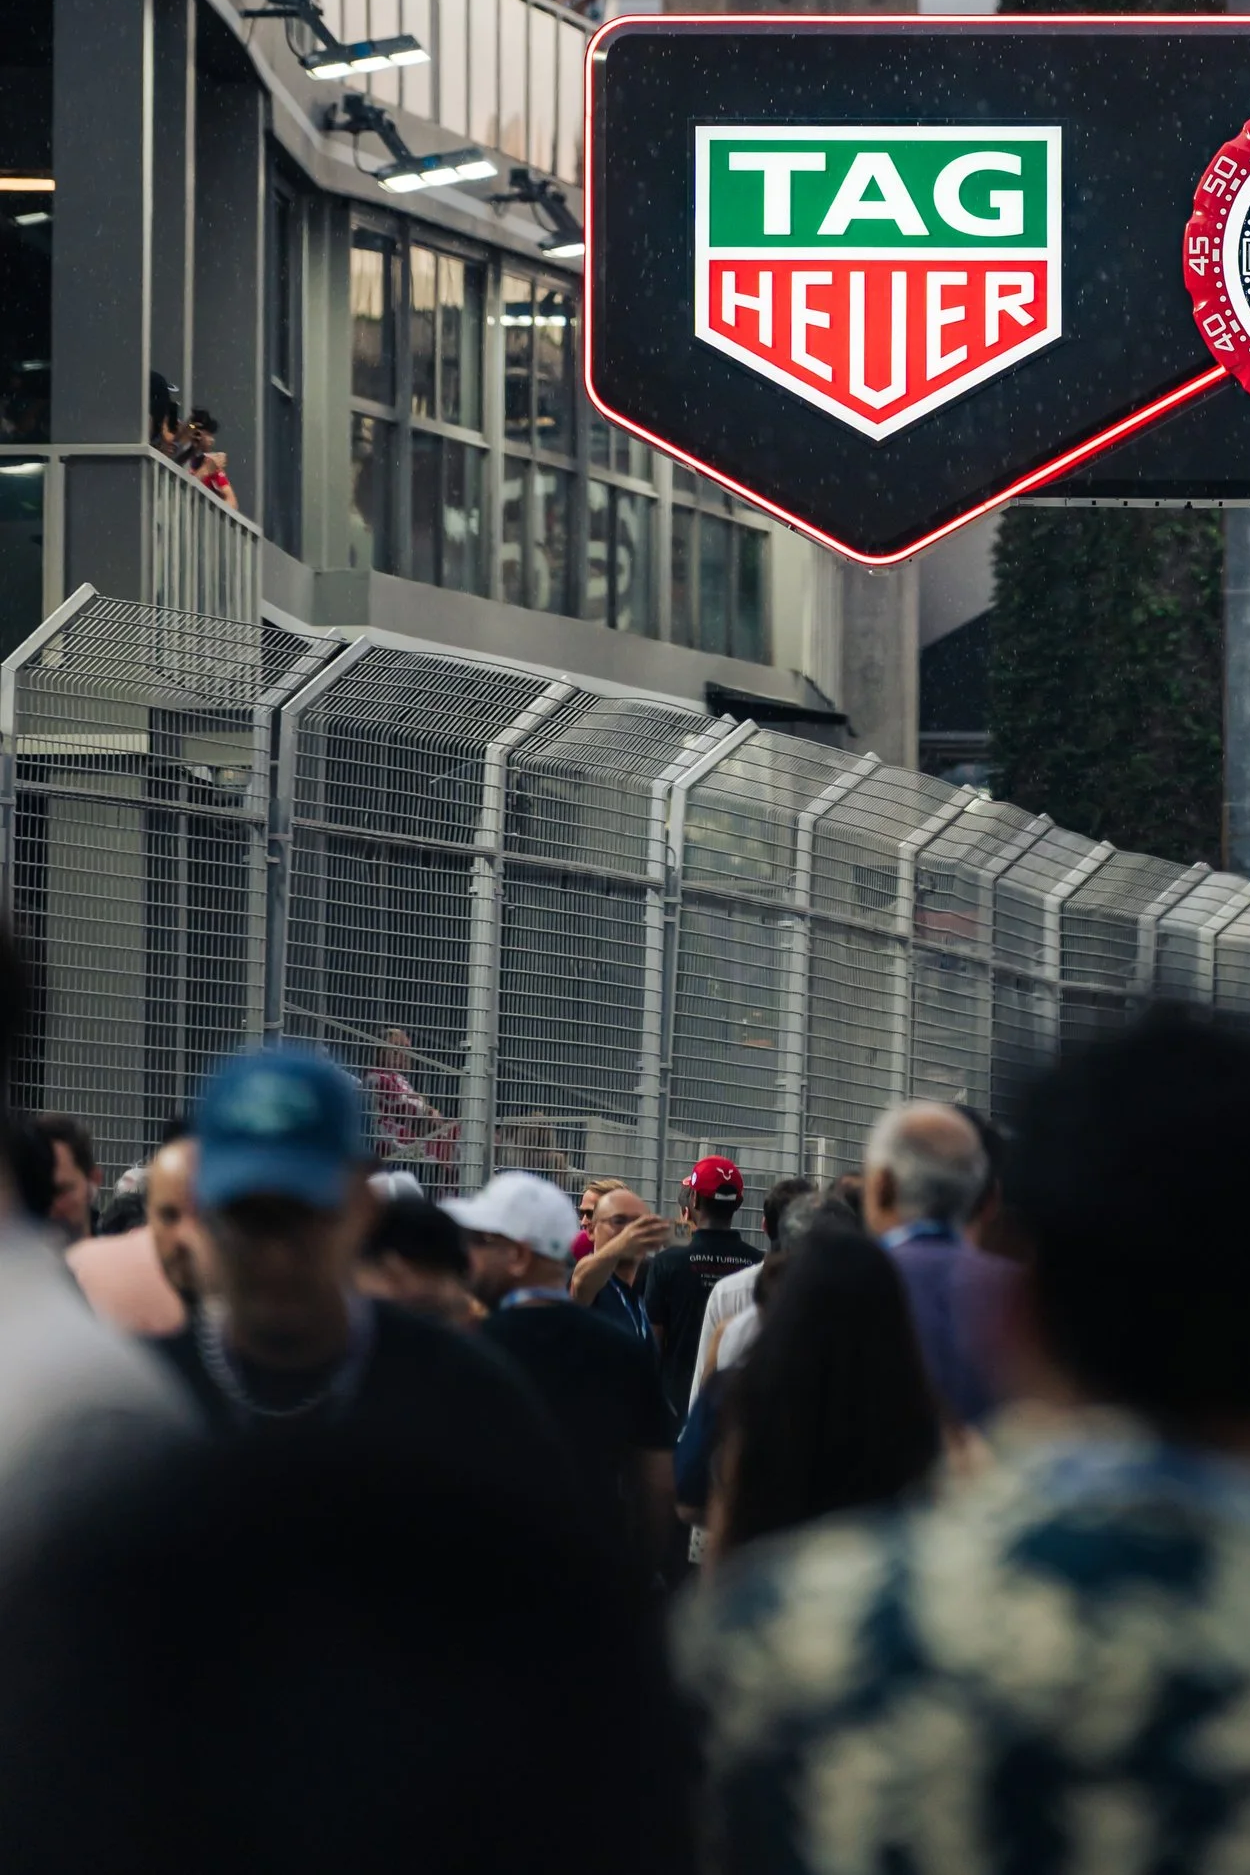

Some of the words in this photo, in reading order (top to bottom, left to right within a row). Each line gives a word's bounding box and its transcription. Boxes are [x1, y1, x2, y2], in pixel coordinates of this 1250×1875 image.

[729, 151, 1024, 237] TAG
[1203, 155, 1238, 198] 50
[1188, 236, 1210, 276] 45
[721, 271, 1035, 409] HEUER
[1203, 313, 1235, 352] 40
[689, 1254, 714, 1263] GRAN
[716, 1255, 753, 1266] TURISMO
